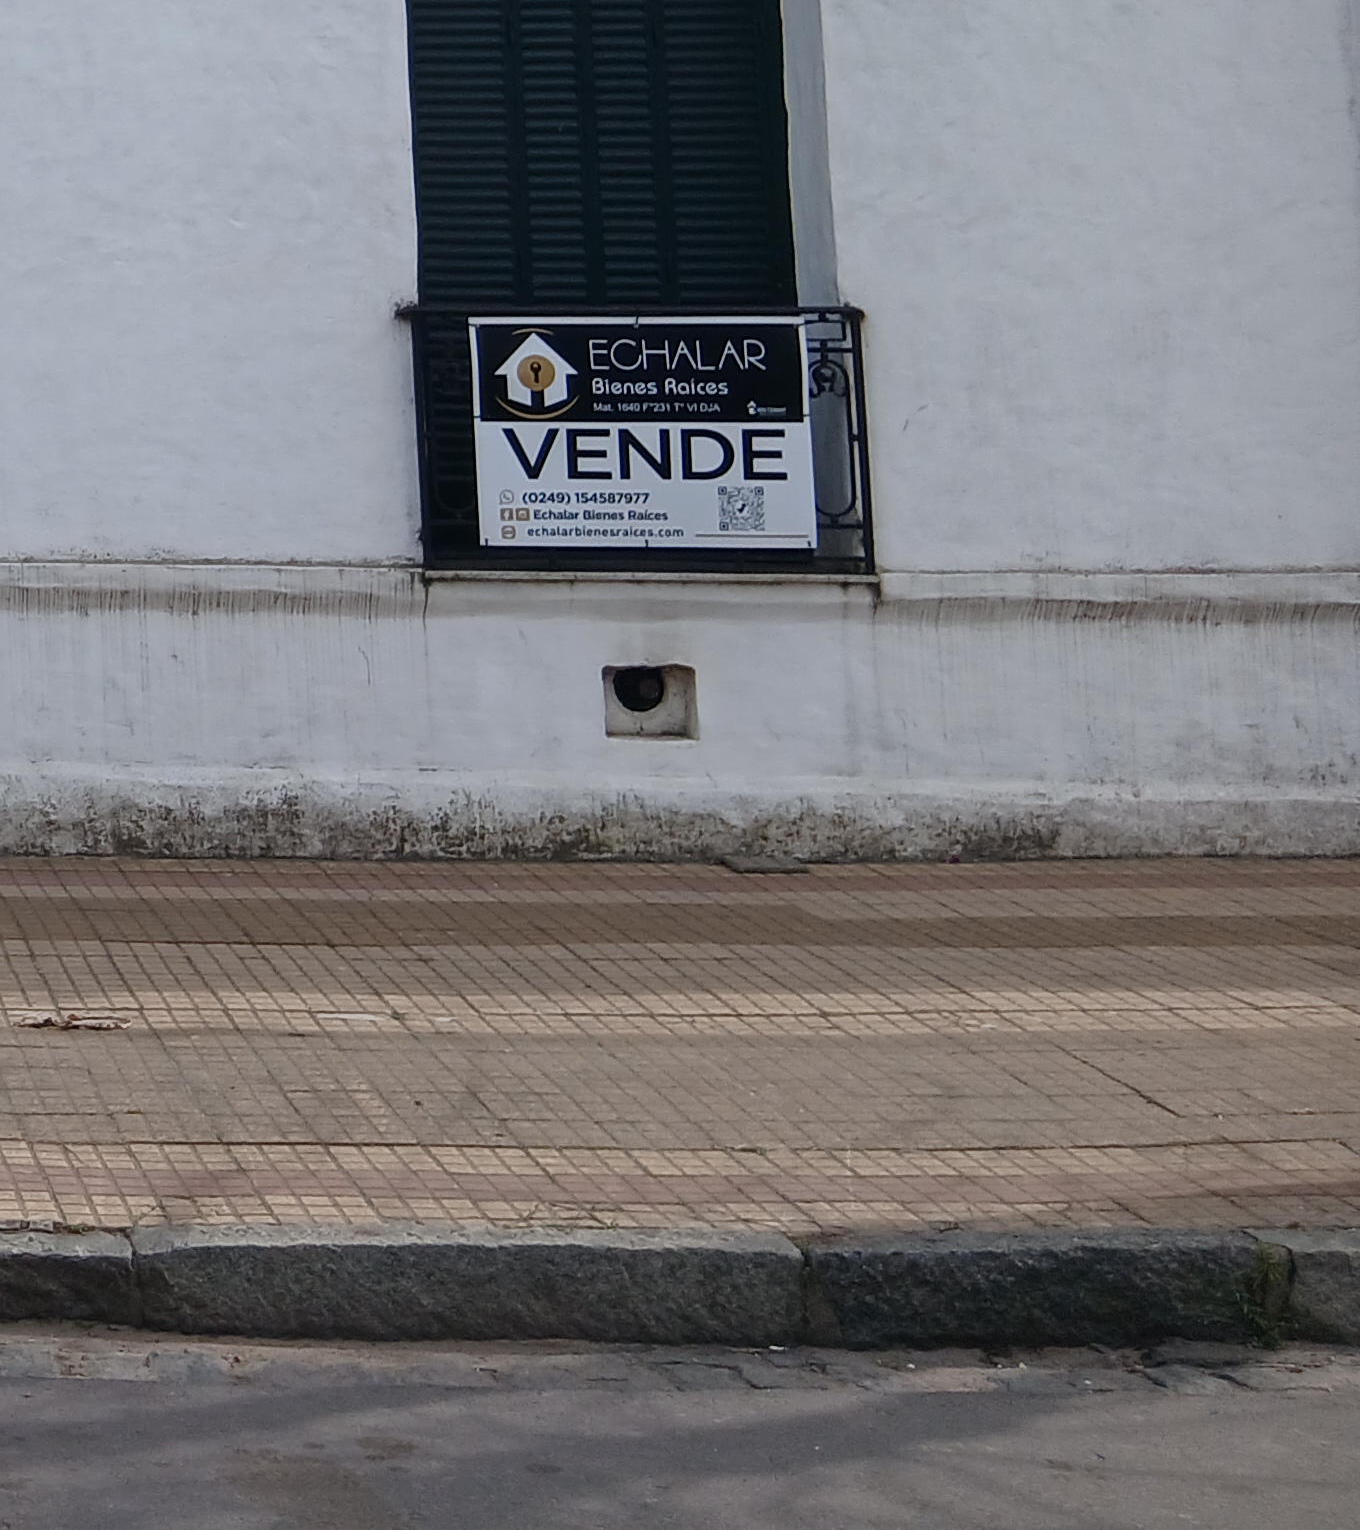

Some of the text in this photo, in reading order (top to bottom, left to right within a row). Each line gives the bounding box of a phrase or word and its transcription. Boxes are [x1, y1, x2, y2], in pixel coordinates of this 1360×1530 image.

[588, 338, 767, 371] ECHALAR
[591, 377, 729, 395] Bienes Raíces
[501, 427, 789, 481] VENDE
[521, 491, 651, 505] (0249) 154587977
[532, 508, 669, 521] Echalar Bienes Raíces
